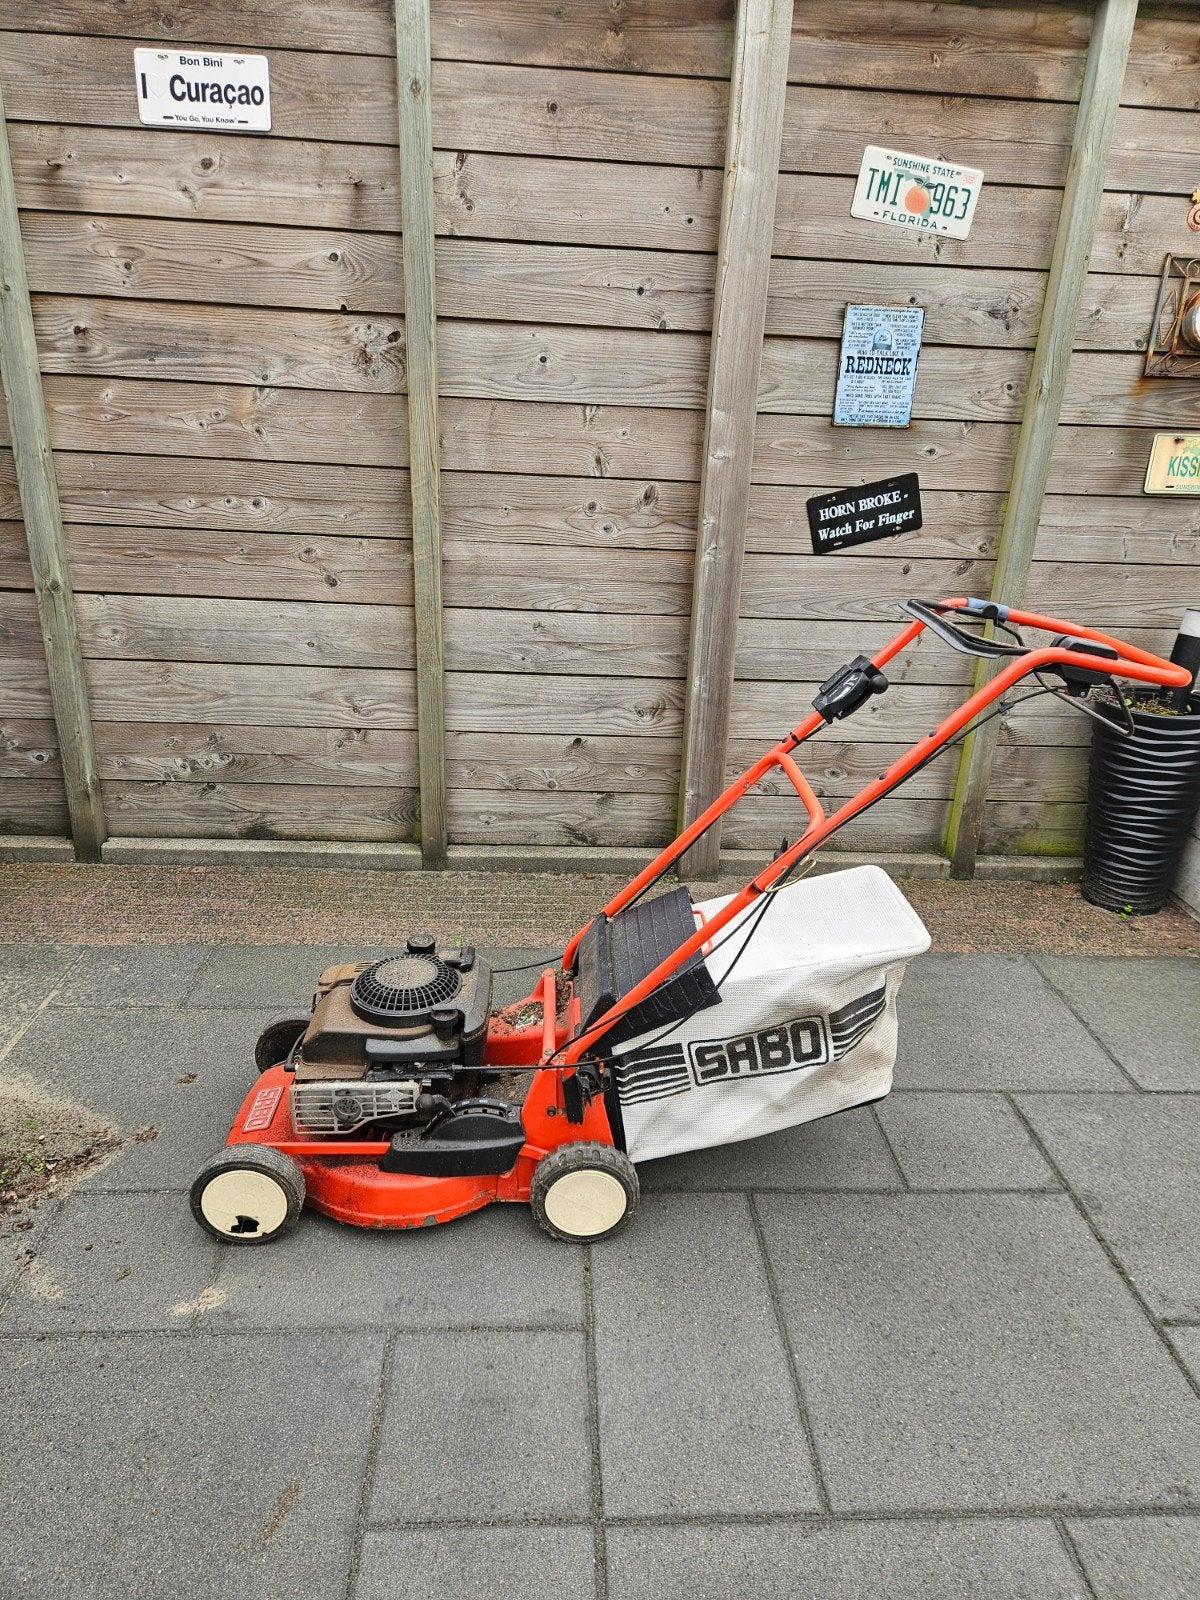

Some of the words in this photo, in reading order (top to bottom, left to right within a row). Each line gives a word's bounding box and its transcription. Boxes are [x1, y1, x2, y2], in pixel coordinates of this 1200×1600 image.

[179, 56, 200, 66] Bon
[203, 57, 223, 67] Bini
[140, 72, 148, 99] I
[169, 74, 265, 109] Curaçao
[201, 115, 214, 123] You
[892, 157, 931, 173] SUNSHINE
[933, 166, 956, 179] STATE
[866, 167, 904, 206] TMI
[929, 182, 972, 220] 963
[882, 210, 938, 230] FLORIDA
[844, 355, 912, 376] REDNECK
[819, 501, 856, 521] HORN
[858, 490, 902, 512] BROKE
[818, 522, 853, 541] Watch
[854, 518, 876, 533] For
[877, 509, 915, 527] Finger
[694, 1020, 822, 1081] SABO
